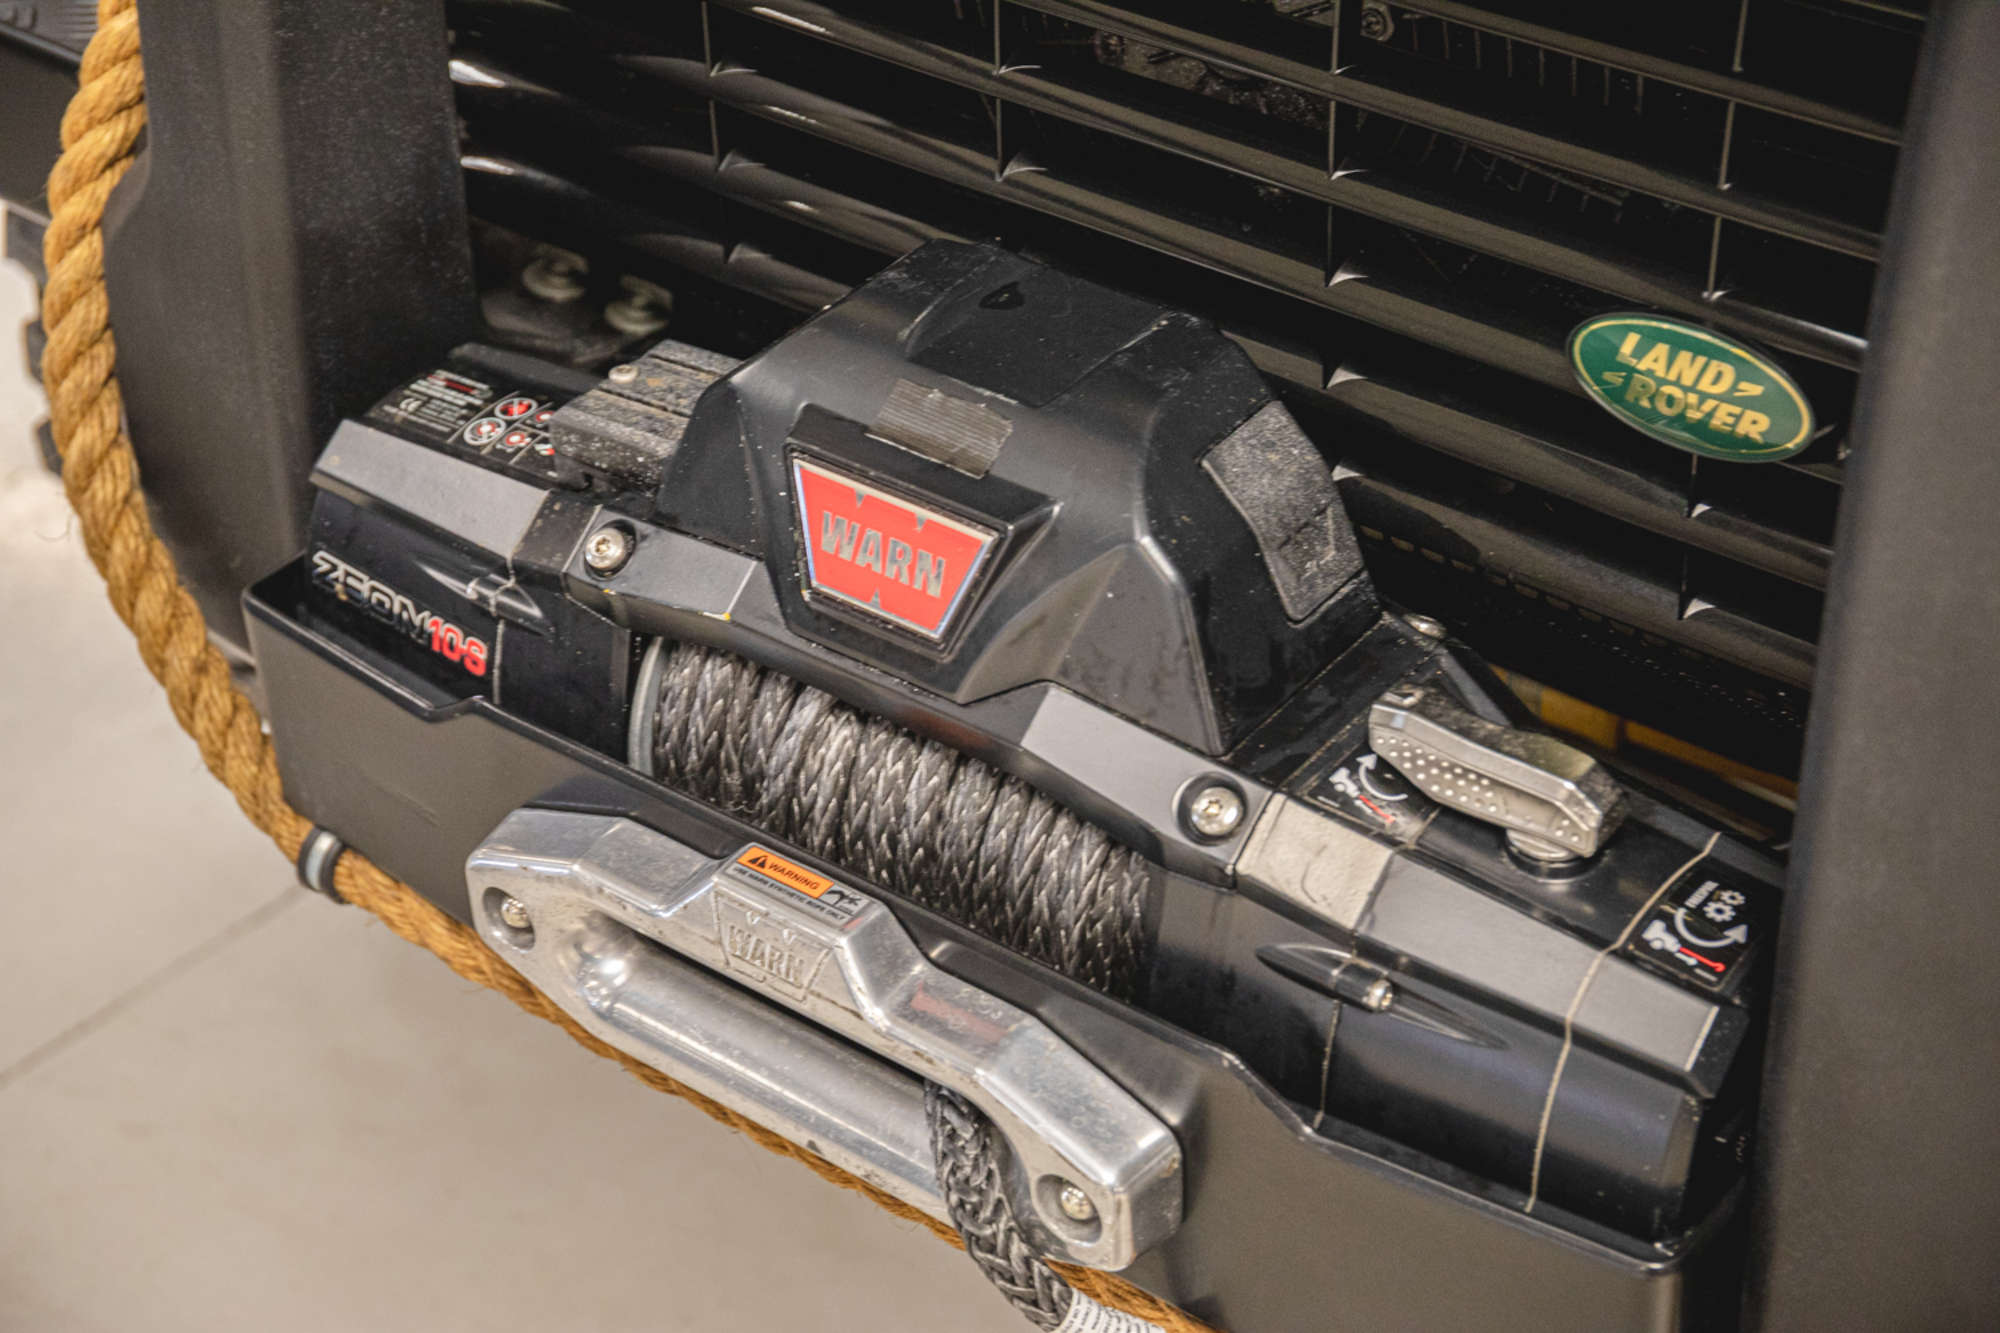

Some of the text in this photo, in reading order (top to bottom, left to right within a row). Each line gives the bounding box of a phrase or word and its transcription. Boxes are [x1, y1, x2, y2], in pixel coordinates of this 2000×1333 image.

[1616, 332, 1736, 395] LAND
[1625, 373, 1770, 444] ROVER
[821, 511, 944, 598] WARN
[769, 862, 820, 890] WARNING
[721, 923, 804, 984] WARN
